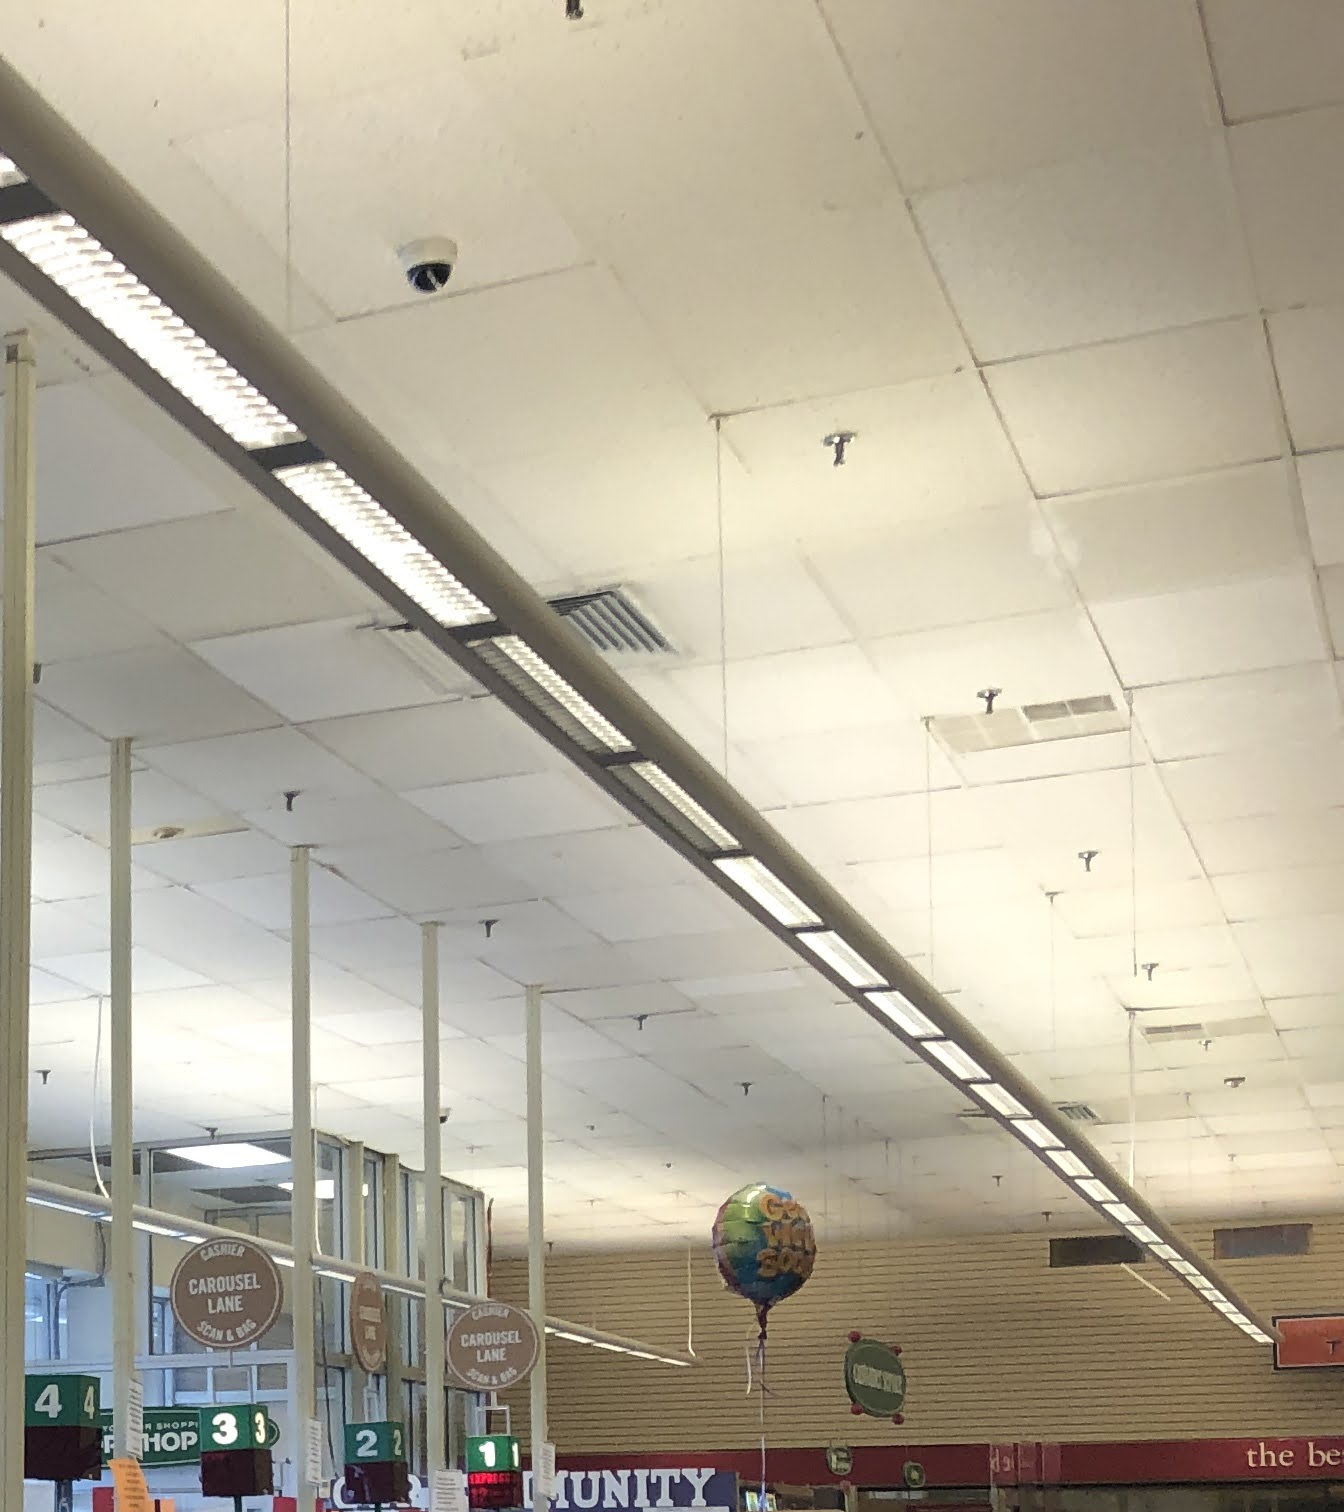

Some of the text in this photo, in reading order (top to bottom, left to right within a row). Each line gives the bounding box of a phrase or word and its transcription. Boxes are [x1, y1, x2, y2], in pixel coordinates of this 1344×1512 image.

[200, 1243, 246, 1262] CASHIER
[188, 1272, 262, 1295] CAROUSEL
[207, 1295, 244, 1314] LANE
[196, 1320, 224, 1341] SCAN
[235, 1318, 257, 1339] BAG
[460, 1328, 522, 1347] CAROUSEL
[476, 1347, 507, 1363] LANE
[34, 1383, 63, 1419] 4
[83, 1384, 96, 1420] 4
[211, 1412, 239, 1445] 3
[253, 1411, 267, 1444] 3
[355, 1429, 379, 1457] 2
[393, 1429, 402, 1456] 2
[477, 1441, 497, 1467] 1
[511, 1441, 519, 1467] 1
[1247, 1442, 1294, 1468] the
